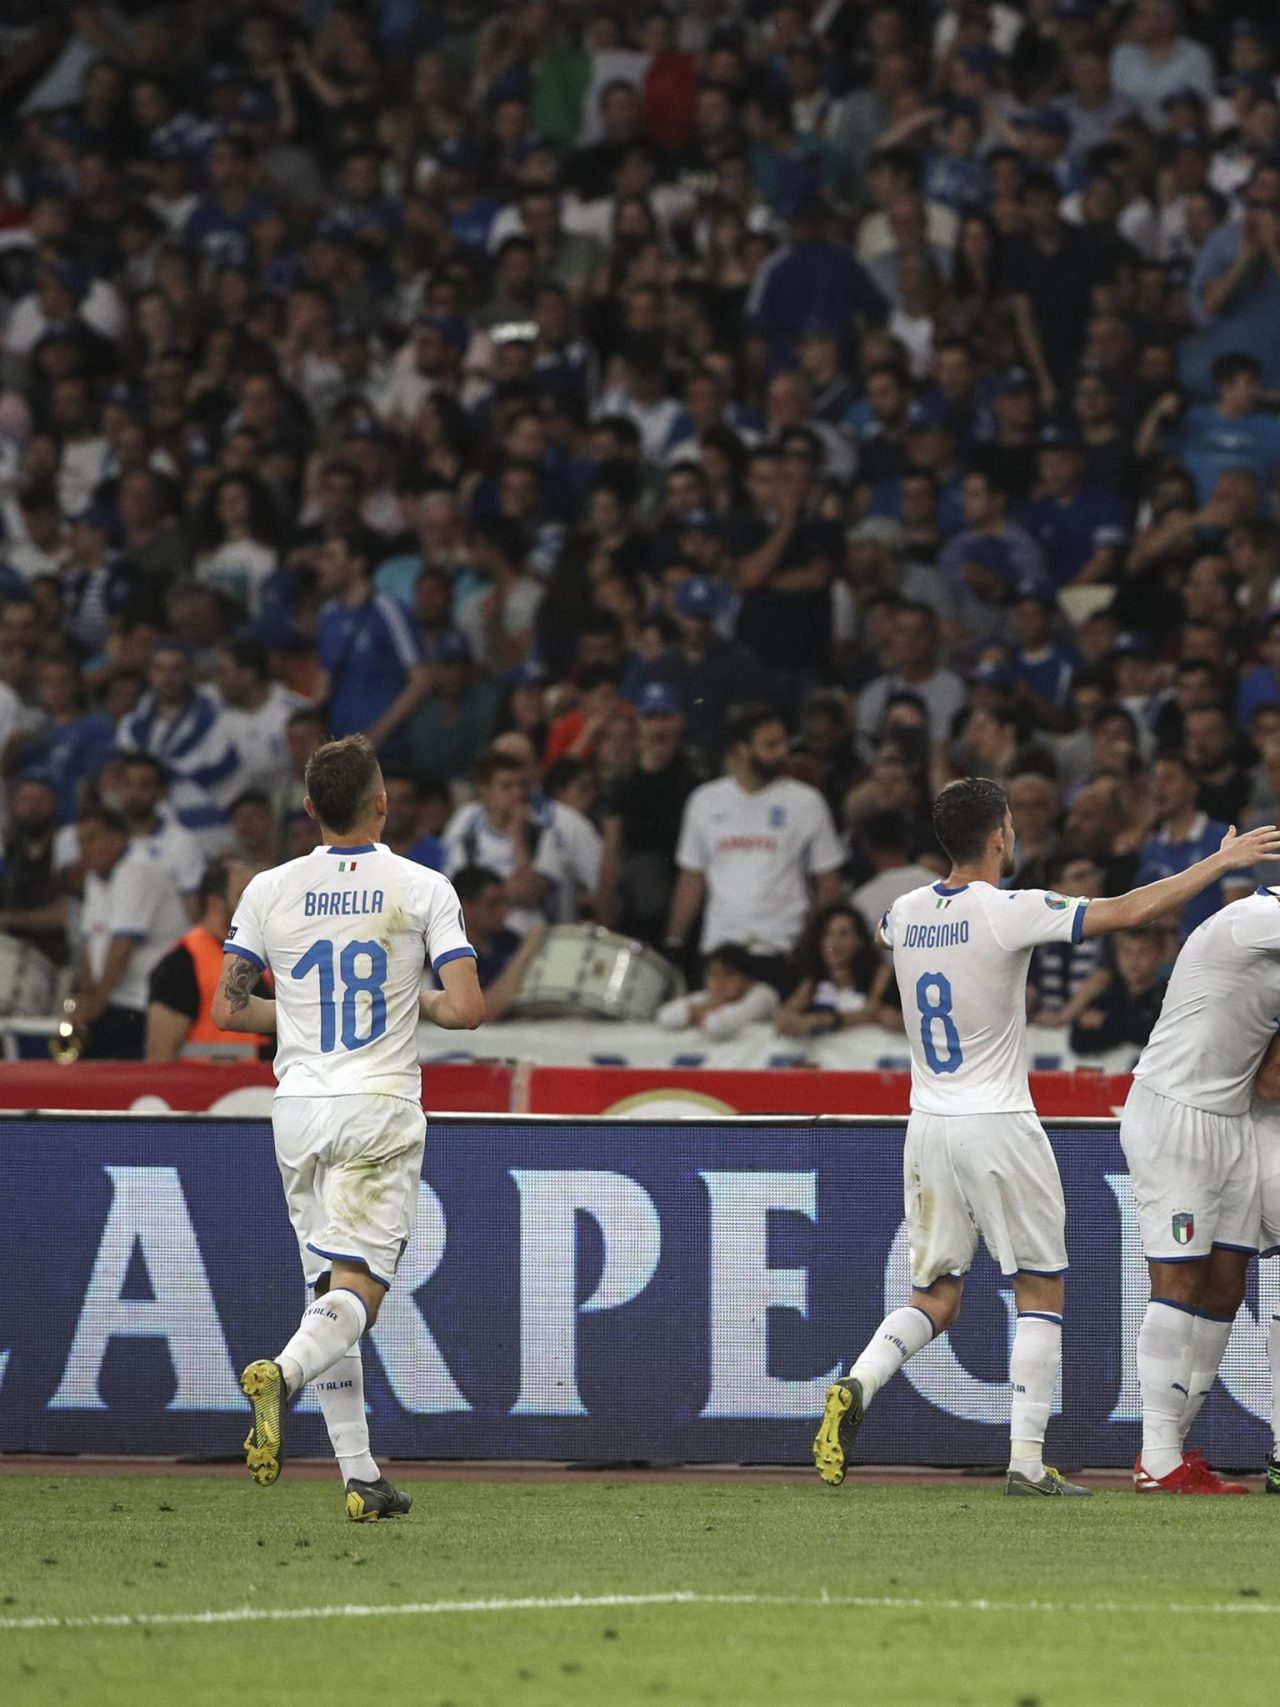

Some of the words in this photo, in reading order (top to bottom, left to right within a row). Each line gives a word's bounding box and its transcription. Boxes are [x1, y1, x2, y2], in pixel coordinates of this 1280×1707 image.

[304, 889, 384, 917] BARELLA
[902, 920, 970, 949] JORGINHO
[291, 939, 388, 1053] 18
[915, 971, 964, 1075] 8
[303, 1307, 338, 1322] ITALIA
[316, 1379, 353, 1391] ITALIA
